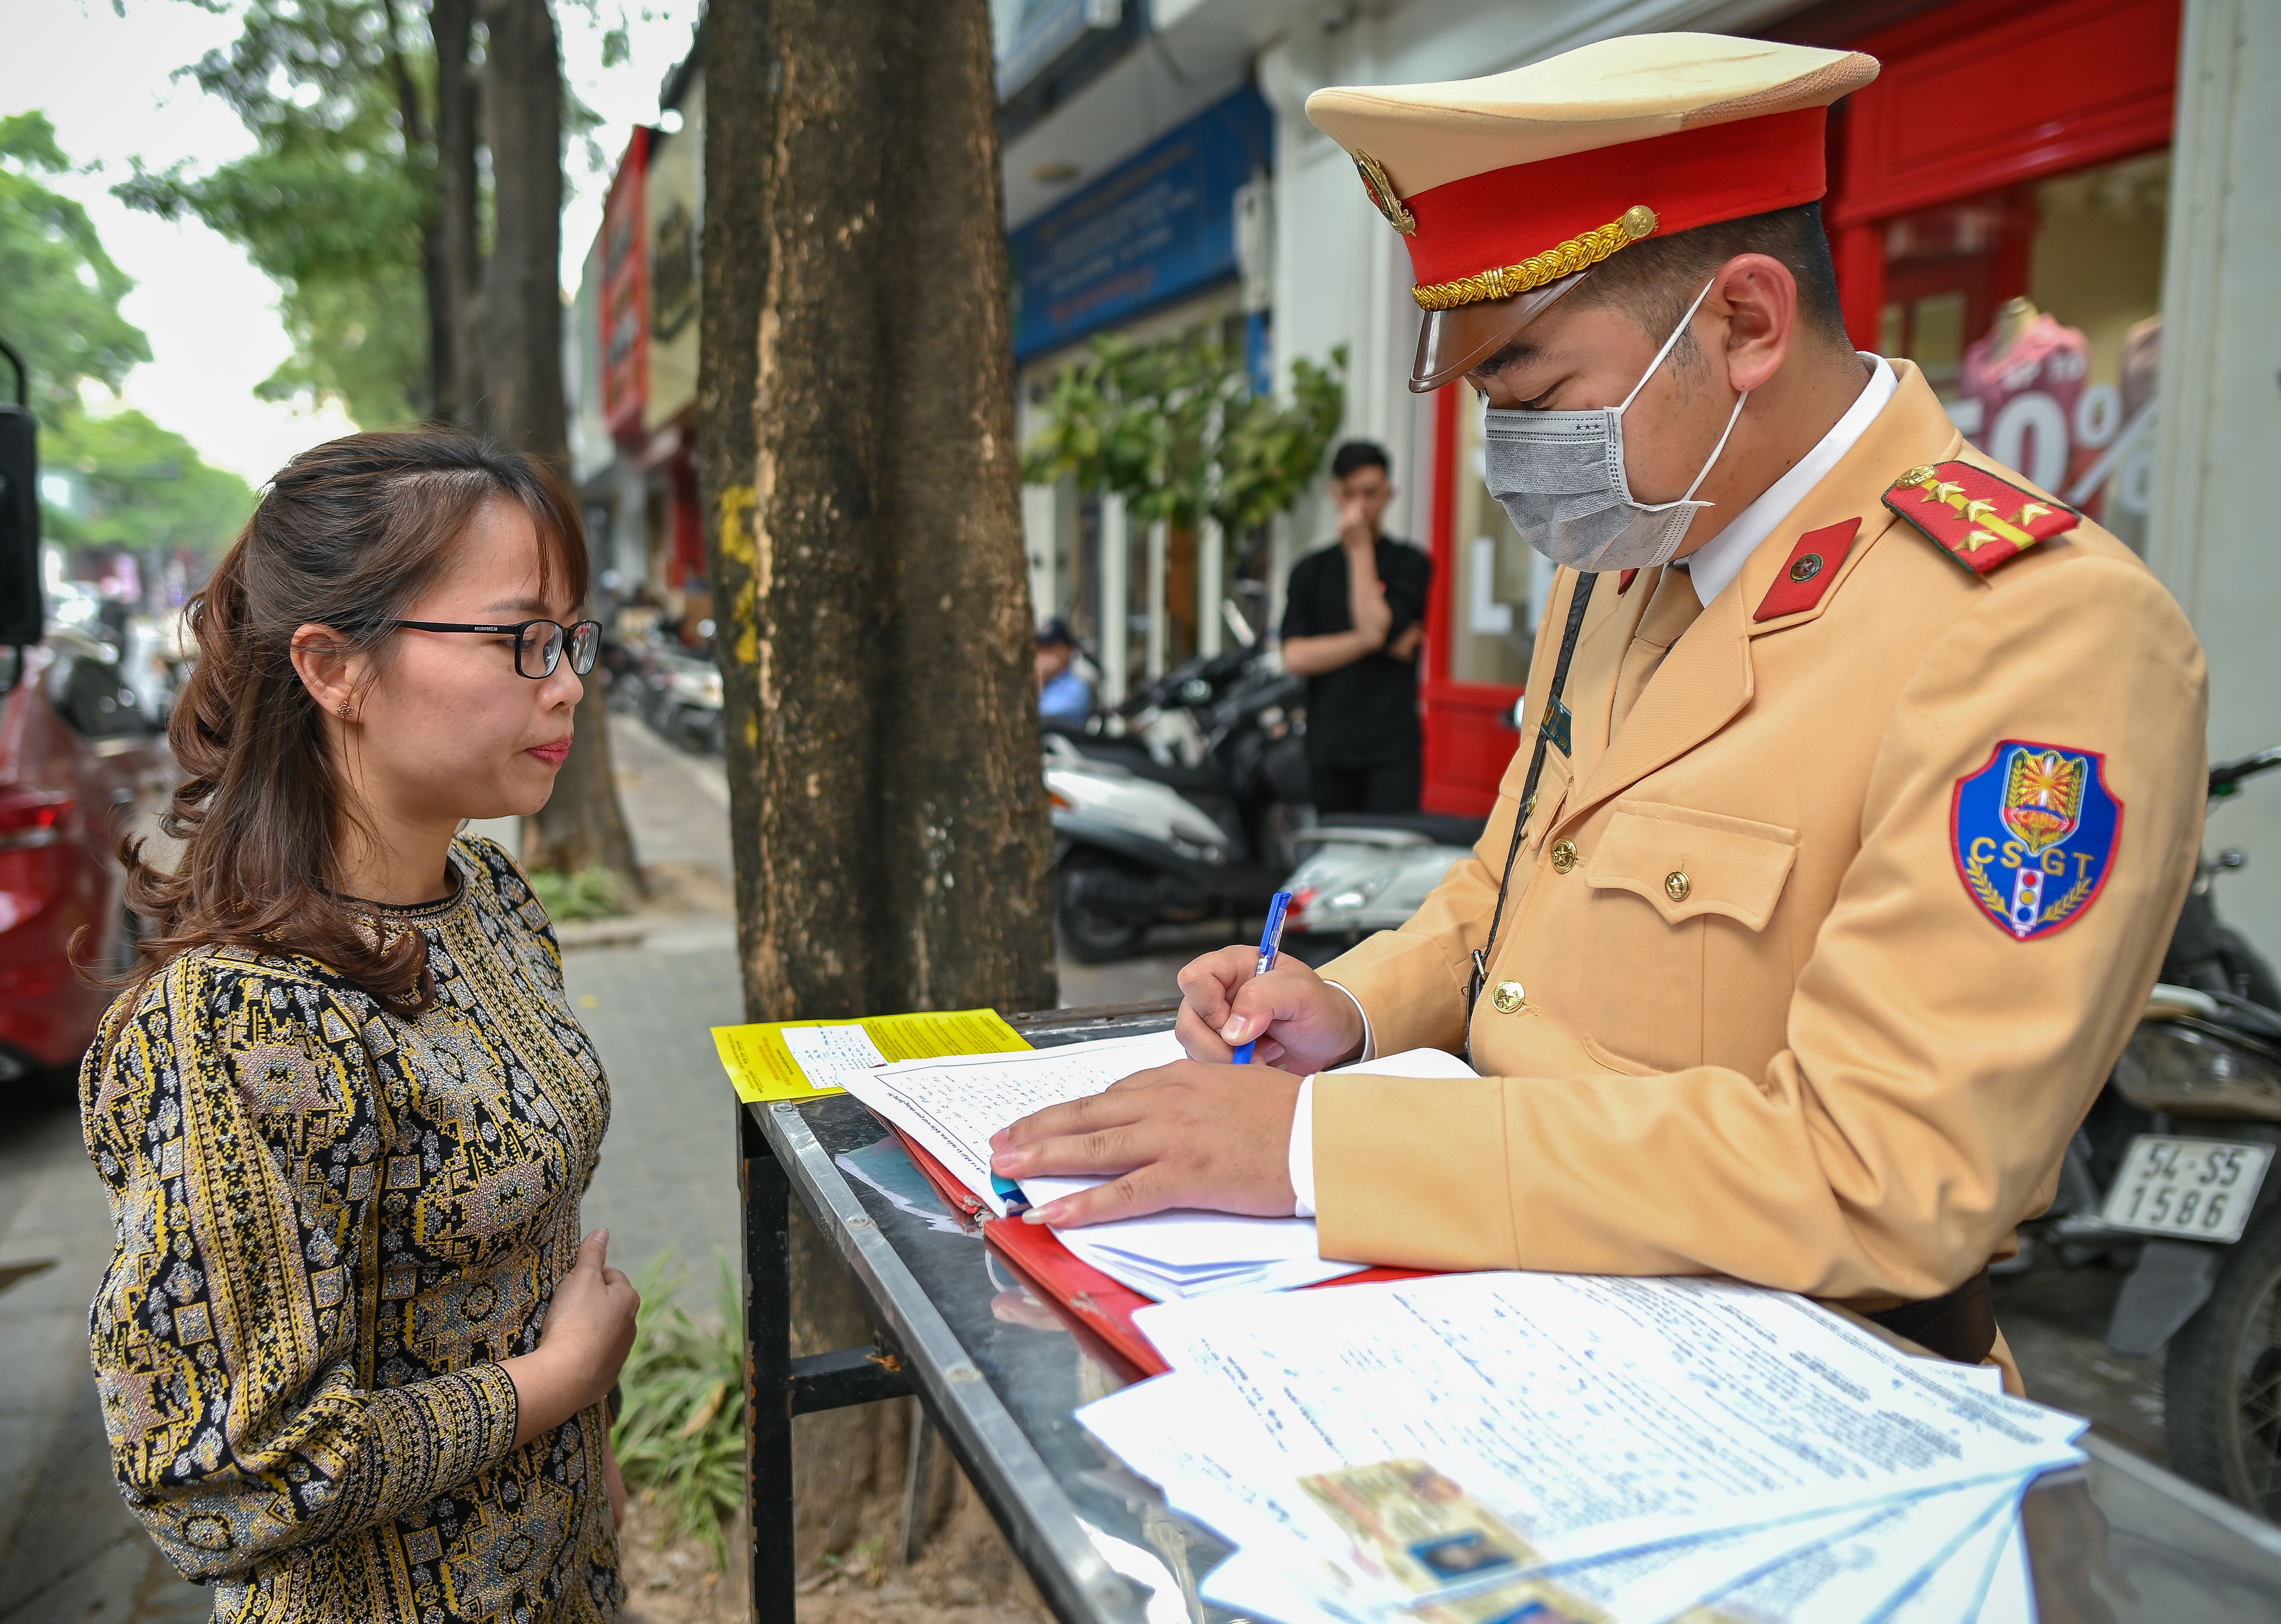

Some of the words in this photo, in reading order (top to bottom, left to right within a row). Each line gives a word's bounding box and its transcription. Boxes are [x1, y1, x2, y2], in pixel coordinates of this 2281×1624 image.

[1947, 385, 2159, 512] 0%
[2020, 812, 2059, 829] CAND
[1970, 837, 2094, 879] CSGT
[2129, 1185, 2230, 1229] 1586
